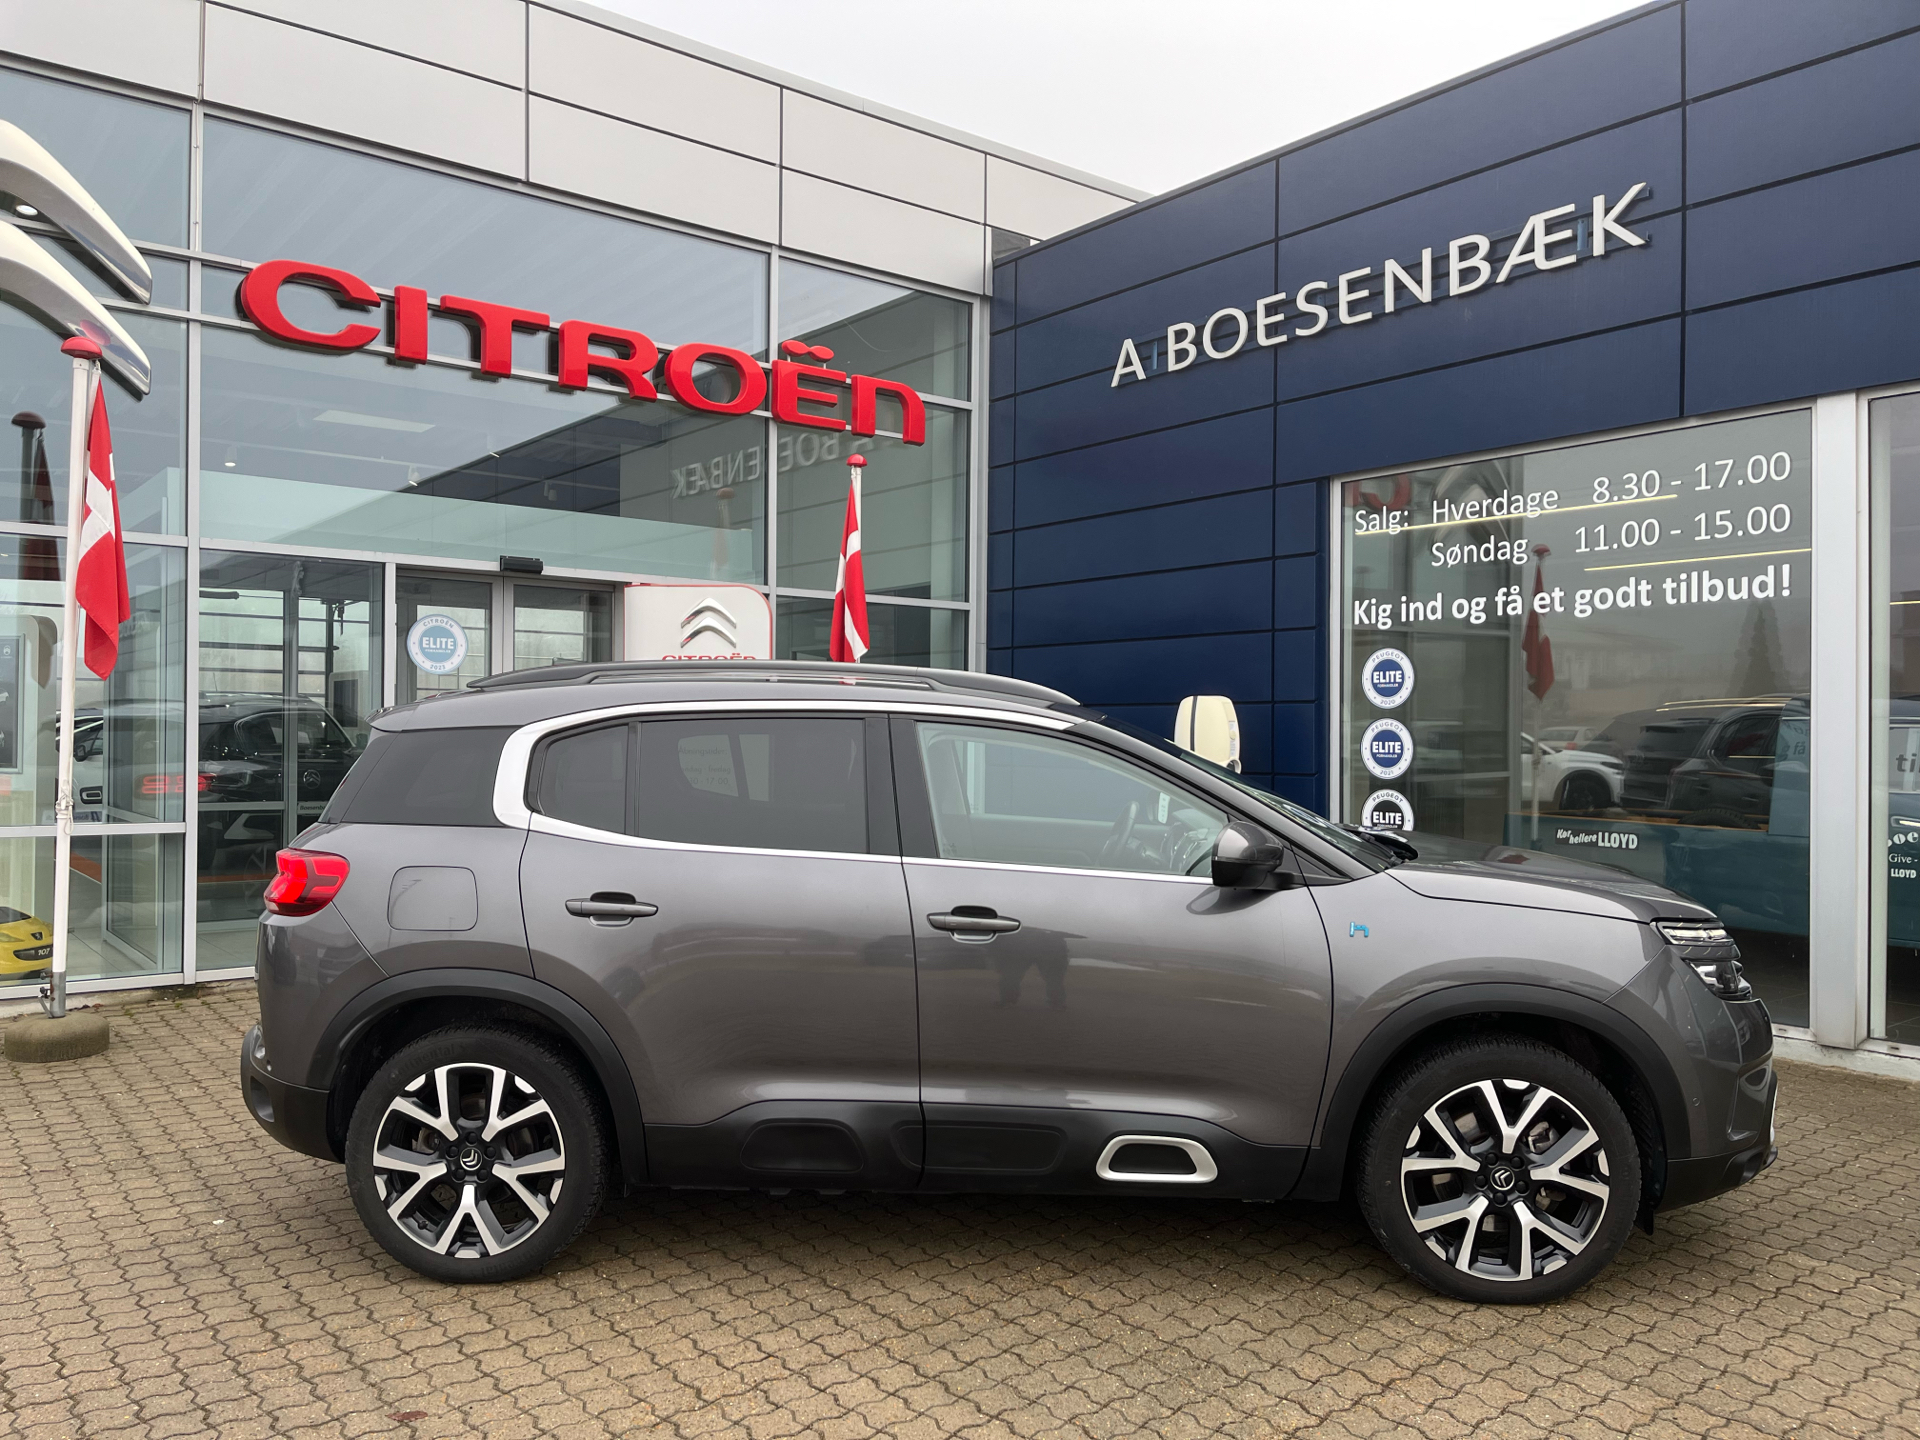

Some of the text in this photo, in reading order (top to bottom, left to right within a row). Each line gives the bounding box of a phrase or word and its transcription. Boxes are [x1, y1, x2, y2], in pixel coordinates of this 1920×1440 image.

[1110, 182, 1647, 388] A BOESENBÆK
[241, 260, 925, 445] CITROËN
[1355, 506, 1409, 534] Salg:
[1433, 490, 1559, 524] Hverdage
[1592, 470, 1661, 504] 8.30
[1694, 451, 1792, 491] 17.00
[1431, 535, 1529, 568] Søndag
[1575, 518, 1660, 553] 11.00
[1694, 504, 1792, 541] 15.00
[1354, 563, 1792, 630] Kig ind og få et godt tilbud!
[423, 618, 454, 629] CITROËN
[422, 636, 454, 649] ELITE
[1371, 651, 1405, 663] PEUGEOT
[1373, 670, 1402, 684] ELITE
[1371, 722, 1404, 733] PEUGEOT
[1372, 741, 1402, 754] ELITE
[1372, 792, 1404, 804] PEUGEOT
[1373, 811, 1402, 825] ELITE
[1598, 832, 1638, 849] LLOYD
[1889, 853, 1912, 864] Give
[1890, 868, 1917, 879] LLOYD
